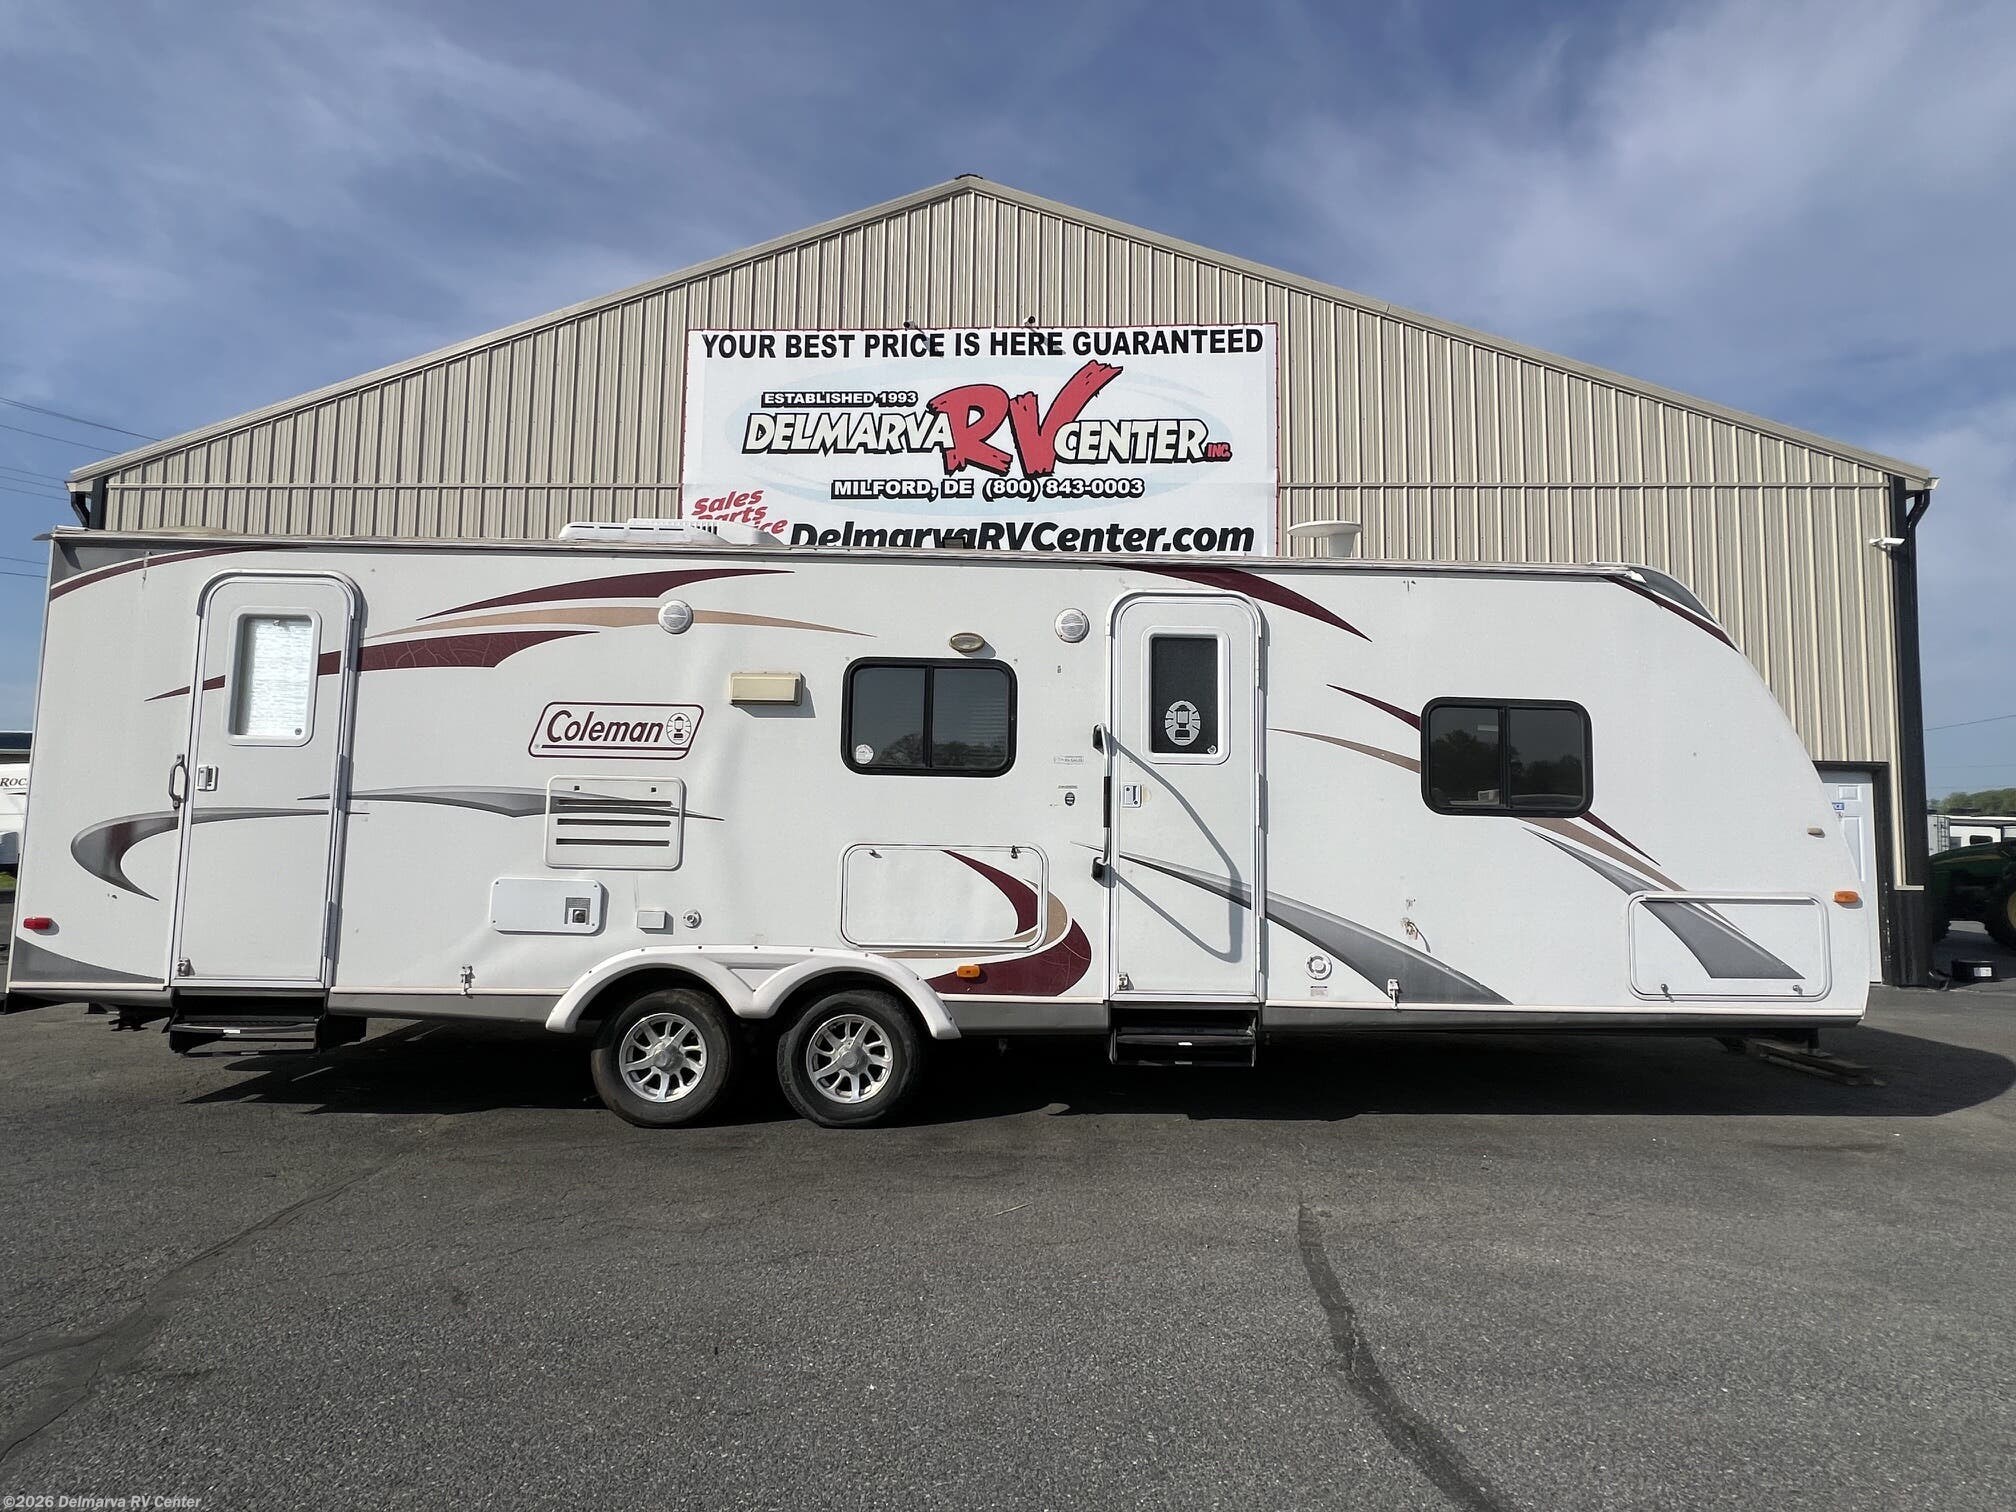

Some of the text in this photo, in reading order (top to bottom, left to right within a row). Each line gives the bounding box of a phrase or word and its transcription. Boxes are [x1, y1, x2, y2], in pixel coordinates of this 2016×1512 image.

[702, 328, 1264, 358] YOUR BEST PRICE IS HERE GUARANTEED
[761, 390, 919, 408] ESTABLISHED 1993
[741, 359, 1233, 479] DELMARVA RV CENTER INC.
[832, 477, 1146, 502] MILFORD, DE (800) 843-0003
[790, 520, 1255, 552] DelmarvaRVCenter.com
[547, 709, 664, 743] Coleman
